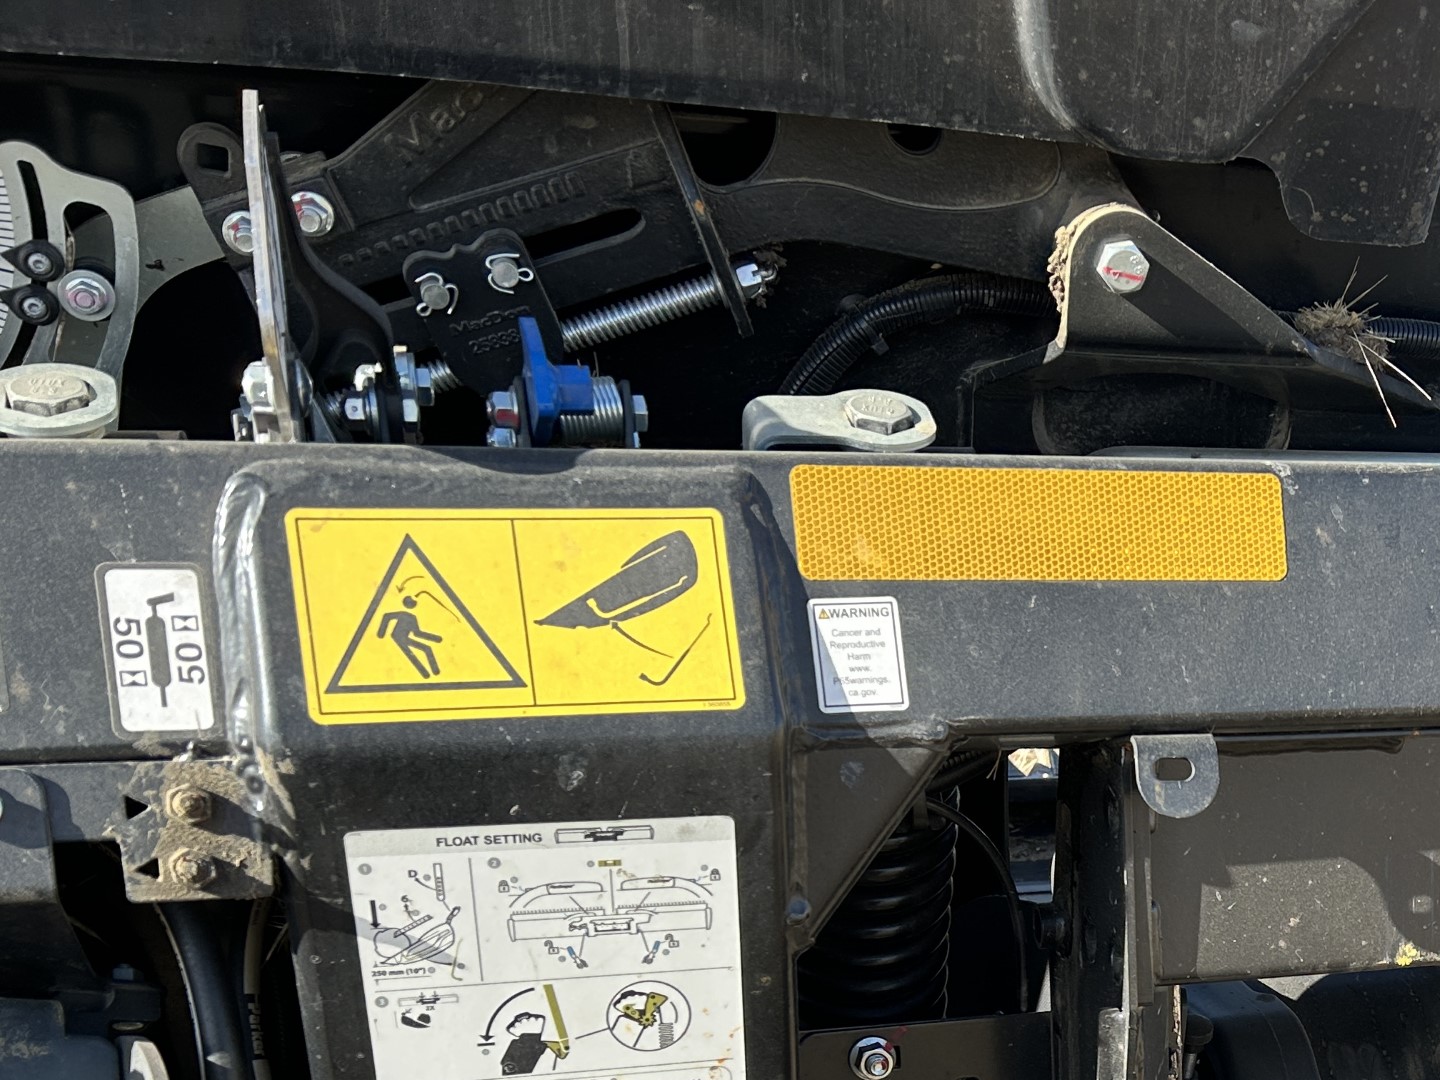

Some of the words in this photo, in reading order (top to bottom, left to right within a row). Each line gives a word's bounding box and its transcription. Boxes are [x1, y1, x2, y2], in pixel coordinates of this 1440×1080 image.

[829, 607, 890, 618] WARNING
[113, 617, 144, 659] 50
[831, 628, 862, 637] Cancer
[865, 628, 881, 636] and
[829, 640, 886, 651] Reproductive
[847, 653, 871, 661] Harm
[175, 643, 205, 685] 50
[436, 835, 480, 848] FLOAT
[484, 833, 543, 845] SETTING
[408, 869, 418, 878] D
